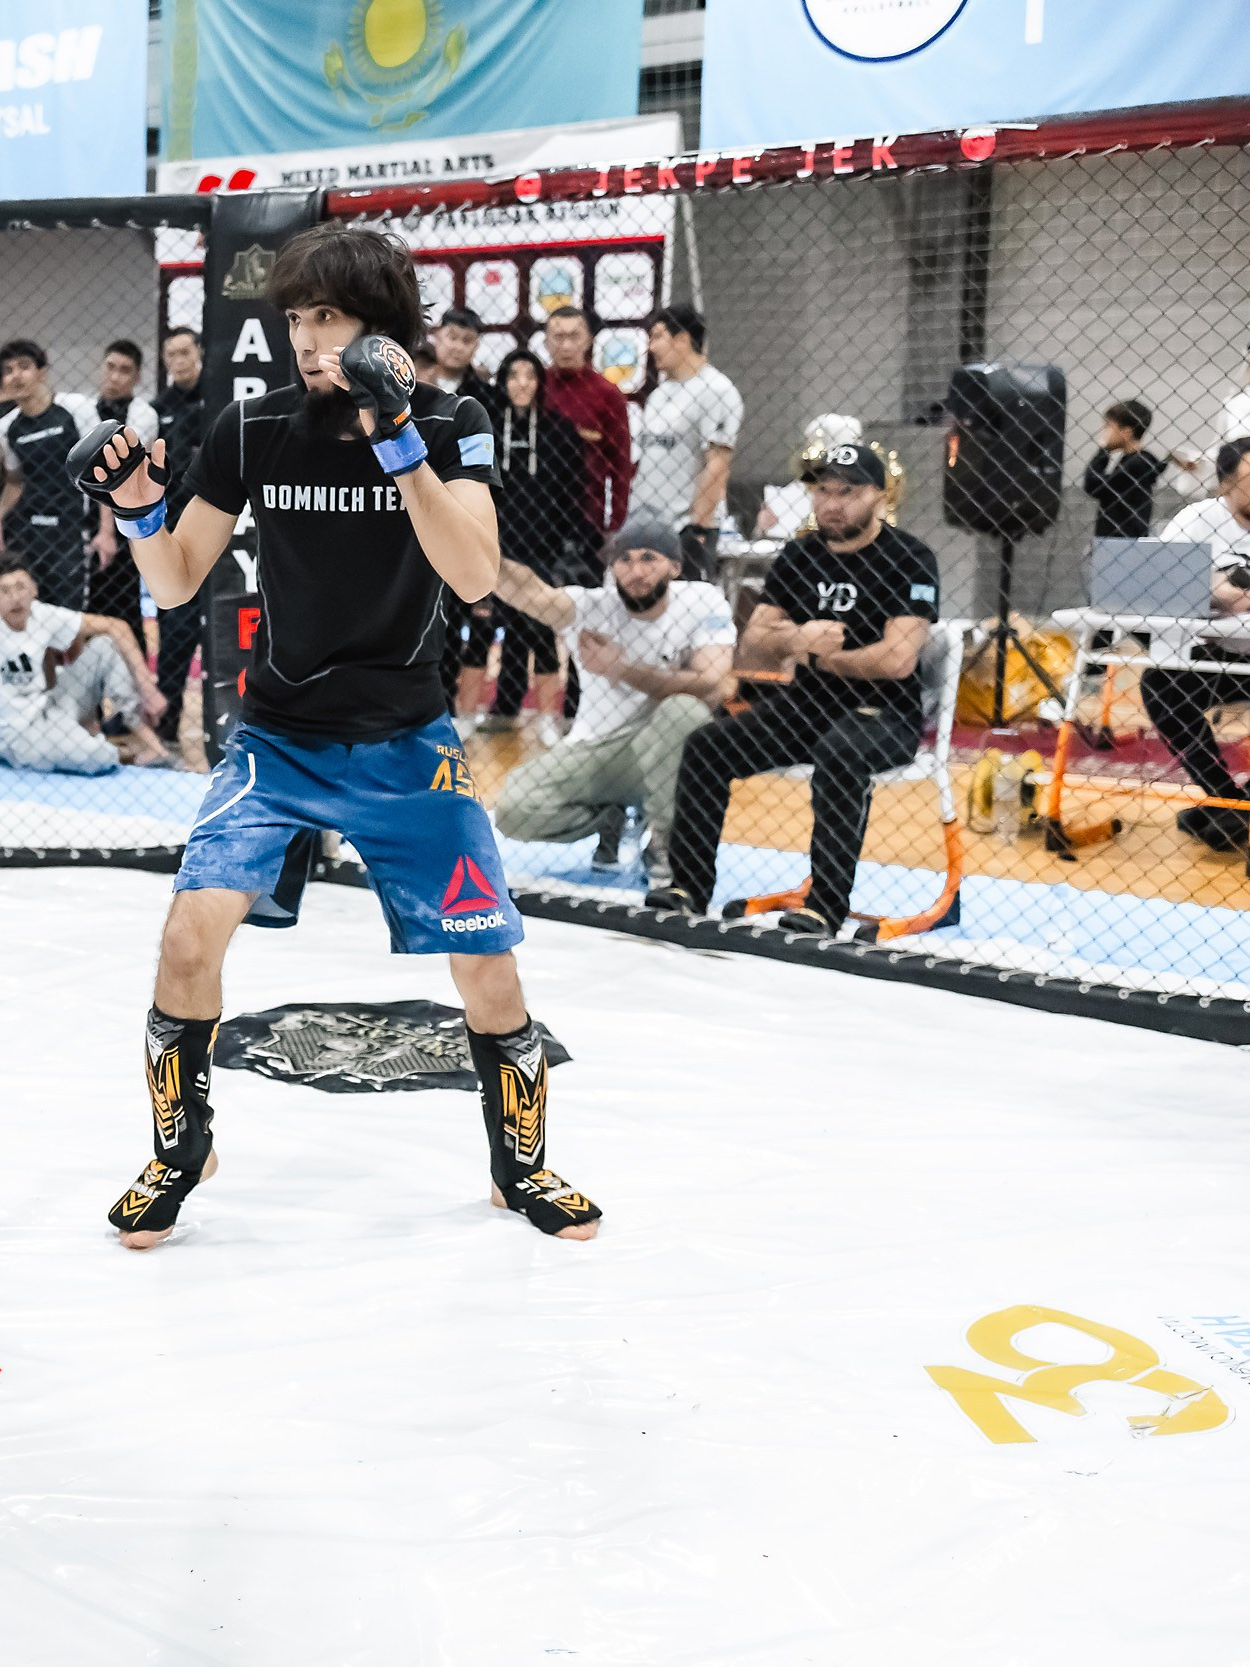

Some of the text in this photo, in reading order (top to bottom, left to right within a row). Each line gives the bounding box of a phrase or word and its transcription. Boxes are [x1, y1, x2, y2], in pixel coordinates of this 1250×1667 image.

[348, 159, 432, 180] MARTIAL
[444, 154, 495, 172] ARTS
[592, 136, 898, 197] JEKPE JEK
[263, 484, 407, 512] DOMNICH TE
[817, 581, 858, 612] YD
[441, 911, 507, 933] Reebok
